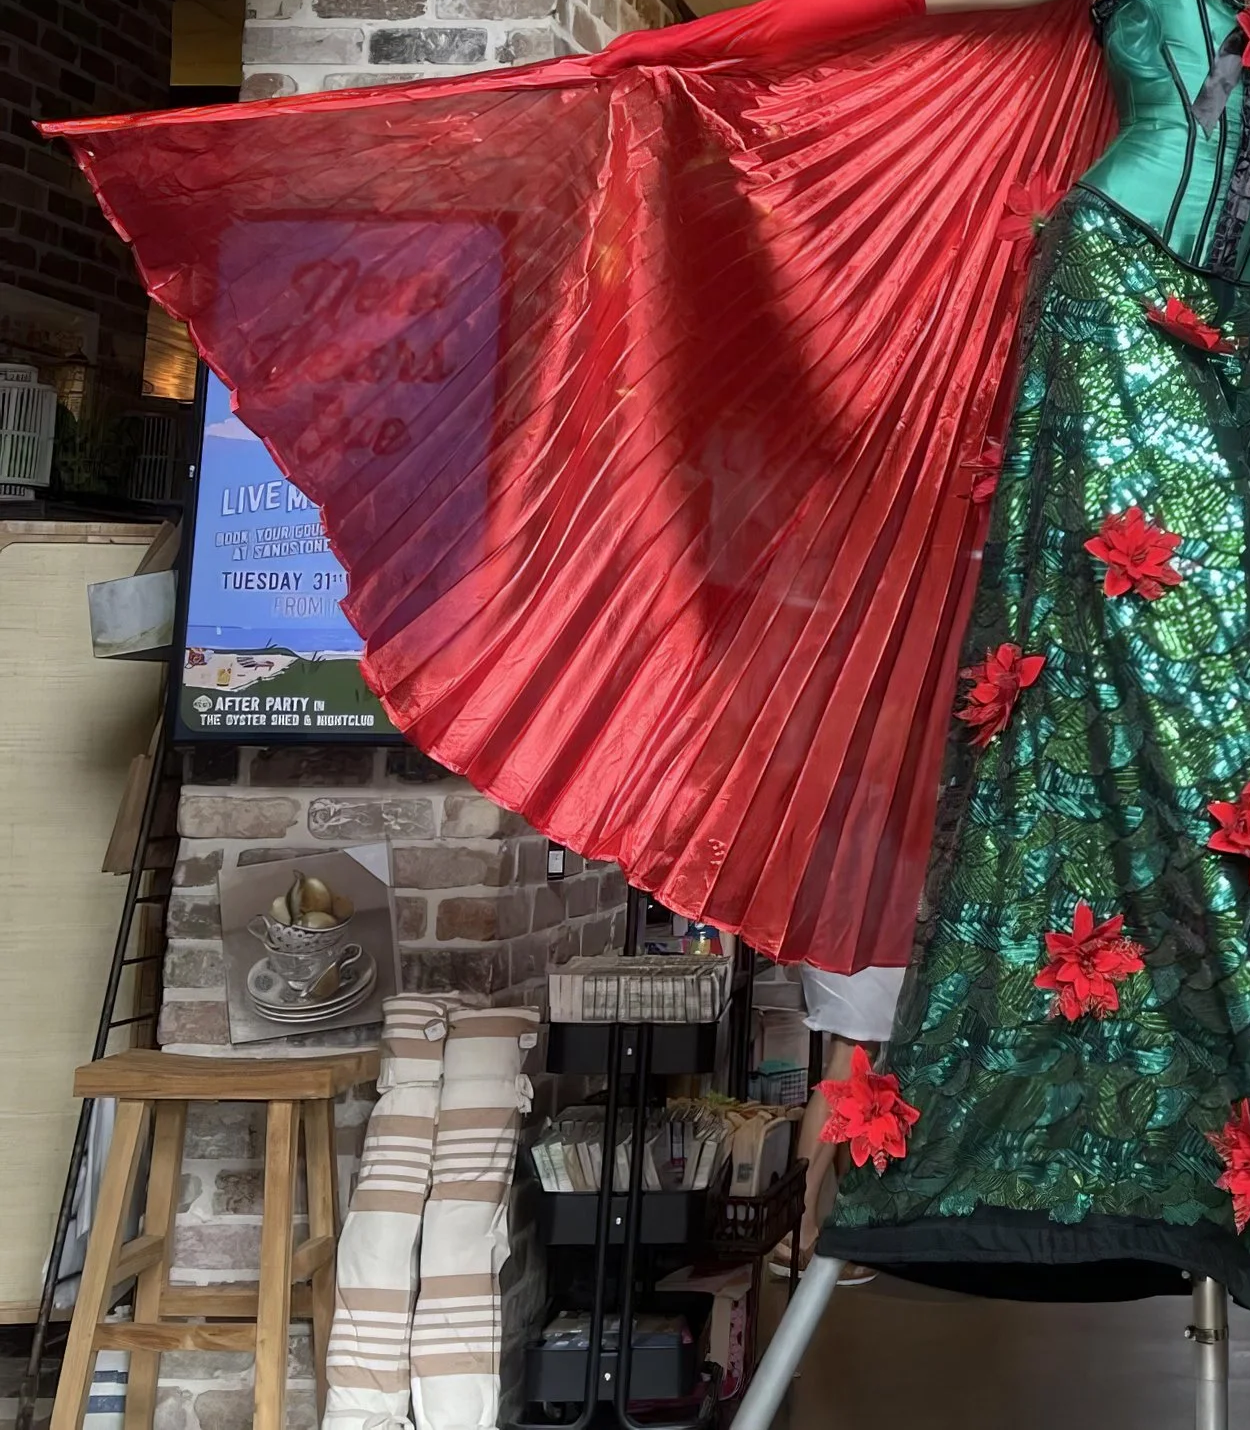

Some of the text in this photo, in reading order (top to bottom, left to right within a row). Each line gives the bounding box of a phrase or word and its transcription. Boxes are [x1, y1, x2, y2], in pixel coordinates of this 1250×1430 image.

[221, 480, 321, 516] LIVE M
[256, 526, 290, 542] YOUR
[232, 546, 248, 561] AT
[222, 571, 303, 590] TUESDAY
[214, 696, 260, 711] AFTER
[265, 696, 310, 711] PARTY
[200, 714, 221, 726] THE
[225, 714, 267, 726] OYSTER
[316, 714, 375, 726] NIGHTCLUB
